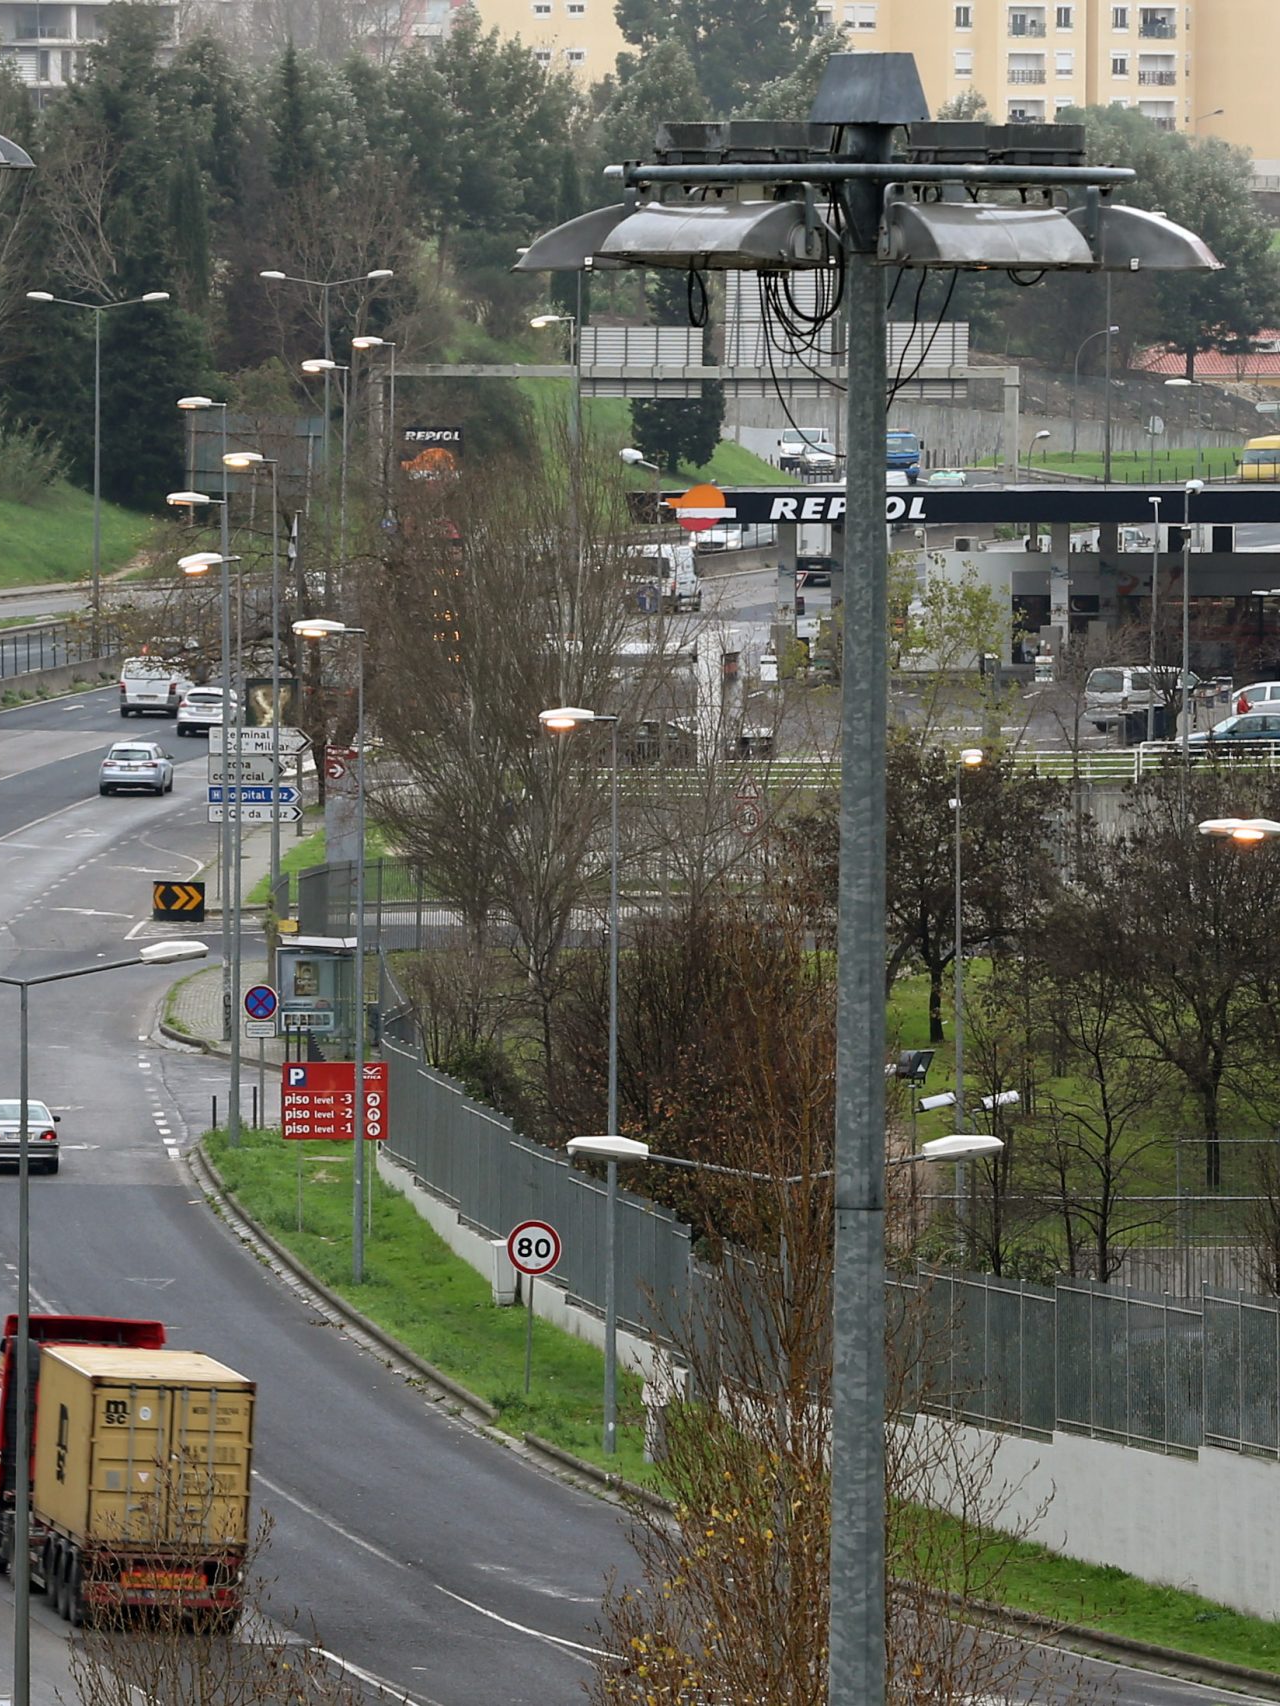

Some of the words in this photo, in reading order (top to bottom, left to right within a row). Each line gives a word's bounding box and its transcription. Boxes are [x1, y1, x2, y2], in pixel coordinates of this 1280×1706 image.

[405, 431, 460, 441] REPSOL
[769, 496, 927, 520] REPOL
[227, 731, 271, 739] teminal
[254, 742, 289, 751] Miliar
[213, 772, 265, 781] comrcial
[226, 790, 266, 801] opital
[248, 809, 261, 818] da
[289, 1068, 304, 1086] P
[285, 1093, 310, 1107] piso
[314, 1096, 334, 1105] level
[340, 1093, 353, 1105] -3
[285, 1108, 310, 1121] piso
[314, 1110, 334, 1119] level
[340, 1108, 353, 1119] -2
[285, 1122, 310, 1136] piso
[314, 1124, 334, 1133] level
[340, 1123, 353, 1133] -1
[517, 1238, 551, 1258] 80
